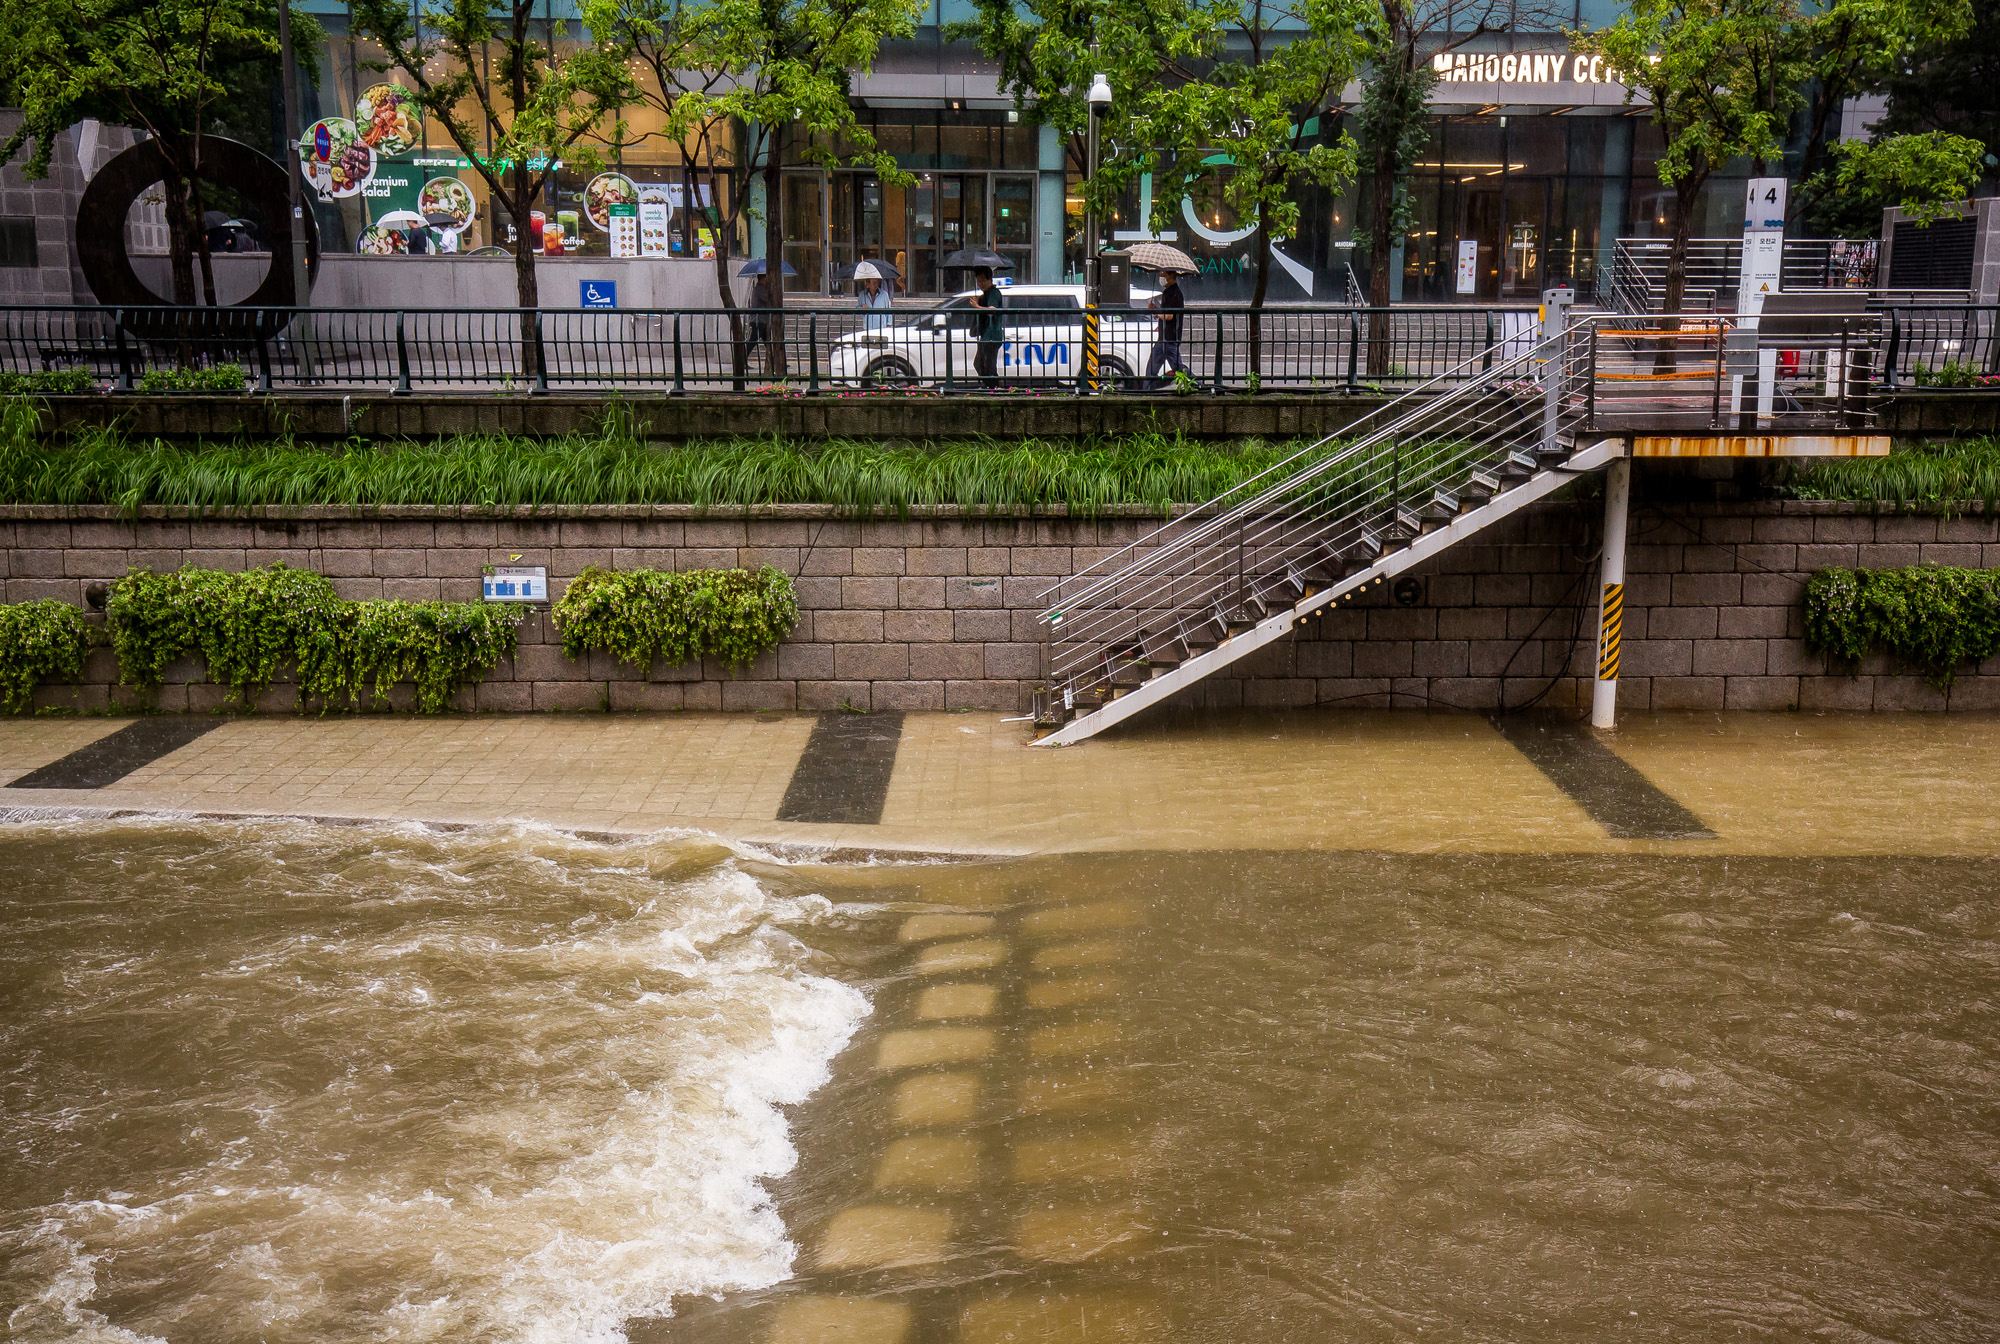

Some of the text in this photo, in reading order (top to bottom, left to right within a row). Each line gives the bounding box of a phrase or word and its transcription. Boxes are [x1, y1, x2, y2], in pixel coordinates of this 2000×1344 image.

[1433, 54, 1567, 83] MAHOGANY
[361, 176, 408, 188] premium
[361, 186, 391, 197] salad
[1748, 187, 1755, 205] 4
[1764, 187, 1777, 205] 4
[645, 209, 662, 217] weekly
[560, 236, 586, 246] coffee
